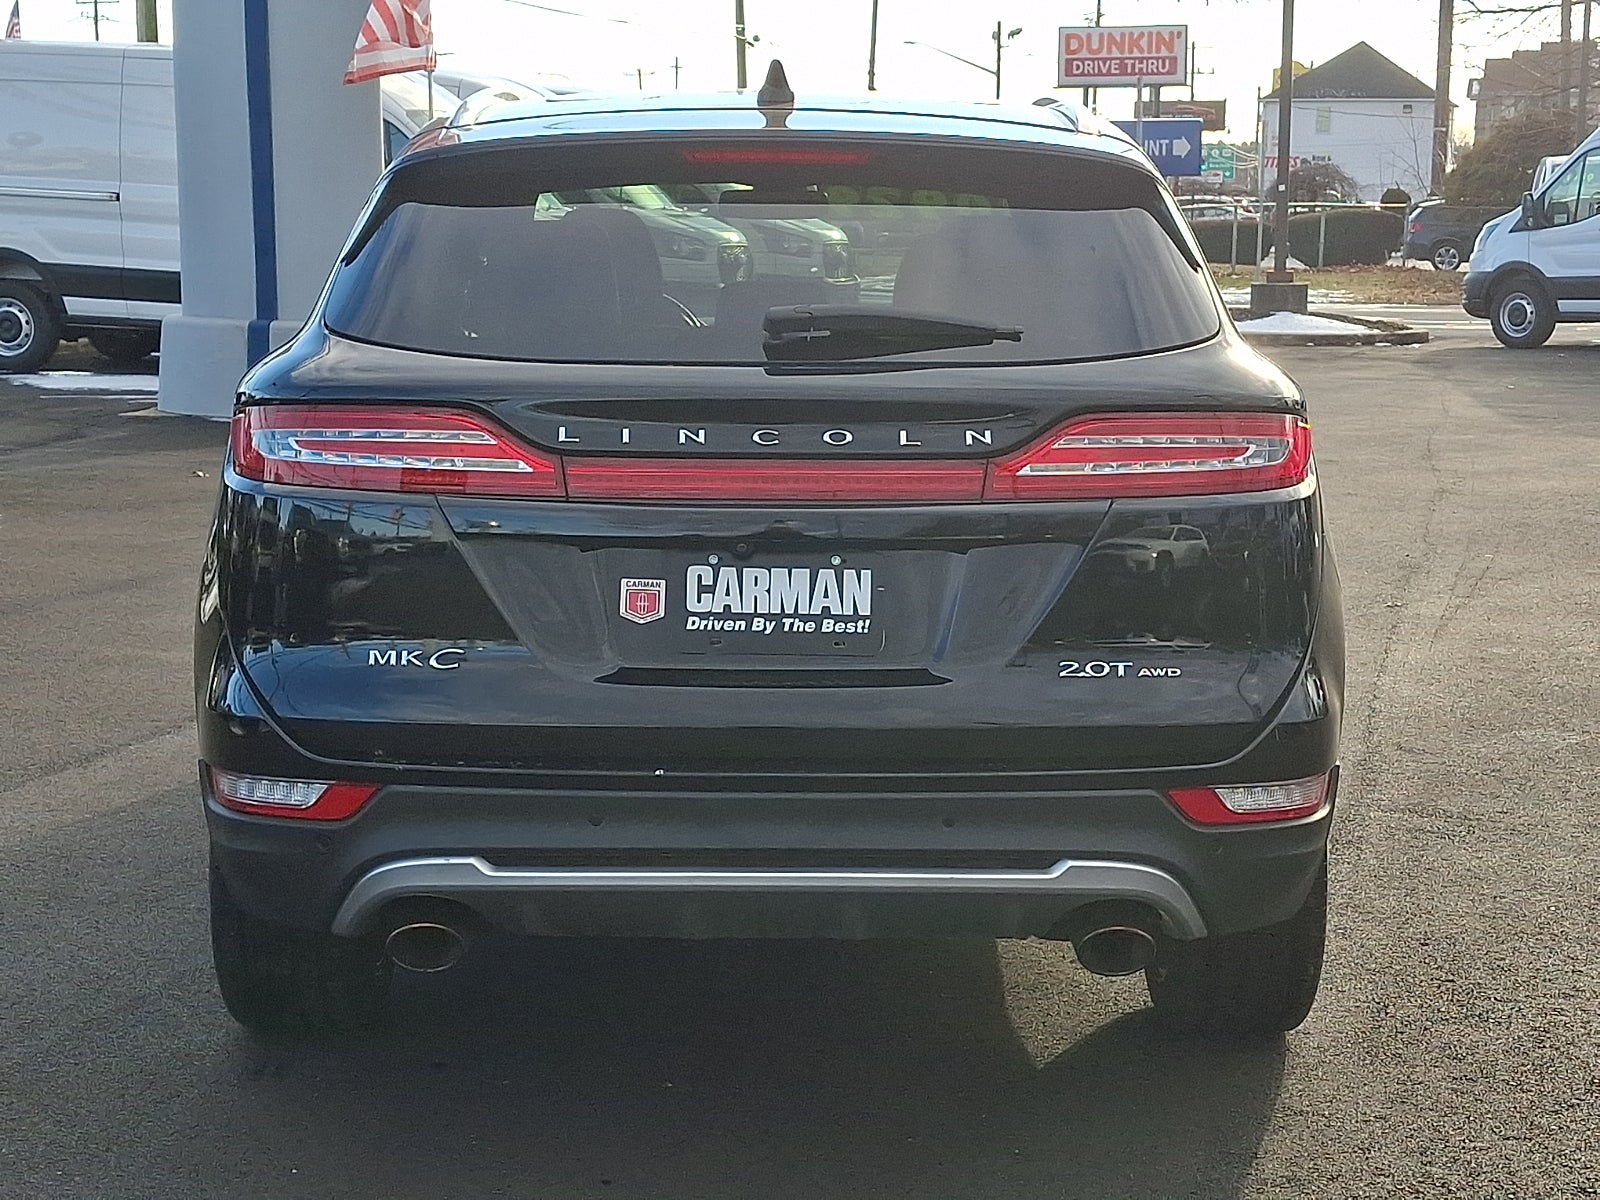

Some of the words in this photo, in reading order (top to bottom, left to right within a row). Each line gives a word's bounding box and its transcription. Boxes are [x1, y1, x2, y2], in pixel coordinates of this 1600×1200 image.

[1065, 31, 1182, 56] DUNKIN'
[1072, 60, 1121, 74] DRIVE
[1125, 59, 1169, 74] THRU
[557, 426, 993, 447] LINCOLN
[625, 580, 662, 588] CARMAN
[686, 564, 873, 616] CARMAN
[686, 616, 747, 632] Driven
[751, 617, 776, 635] By
[782, 618, 816, 633] The
[821, 618, 871, 634] Best!
[368, 648, 465, 670] MKC
[1058, 661, 1134, 678] 2.0T
[1137, 667, 1182, 677] AWD
